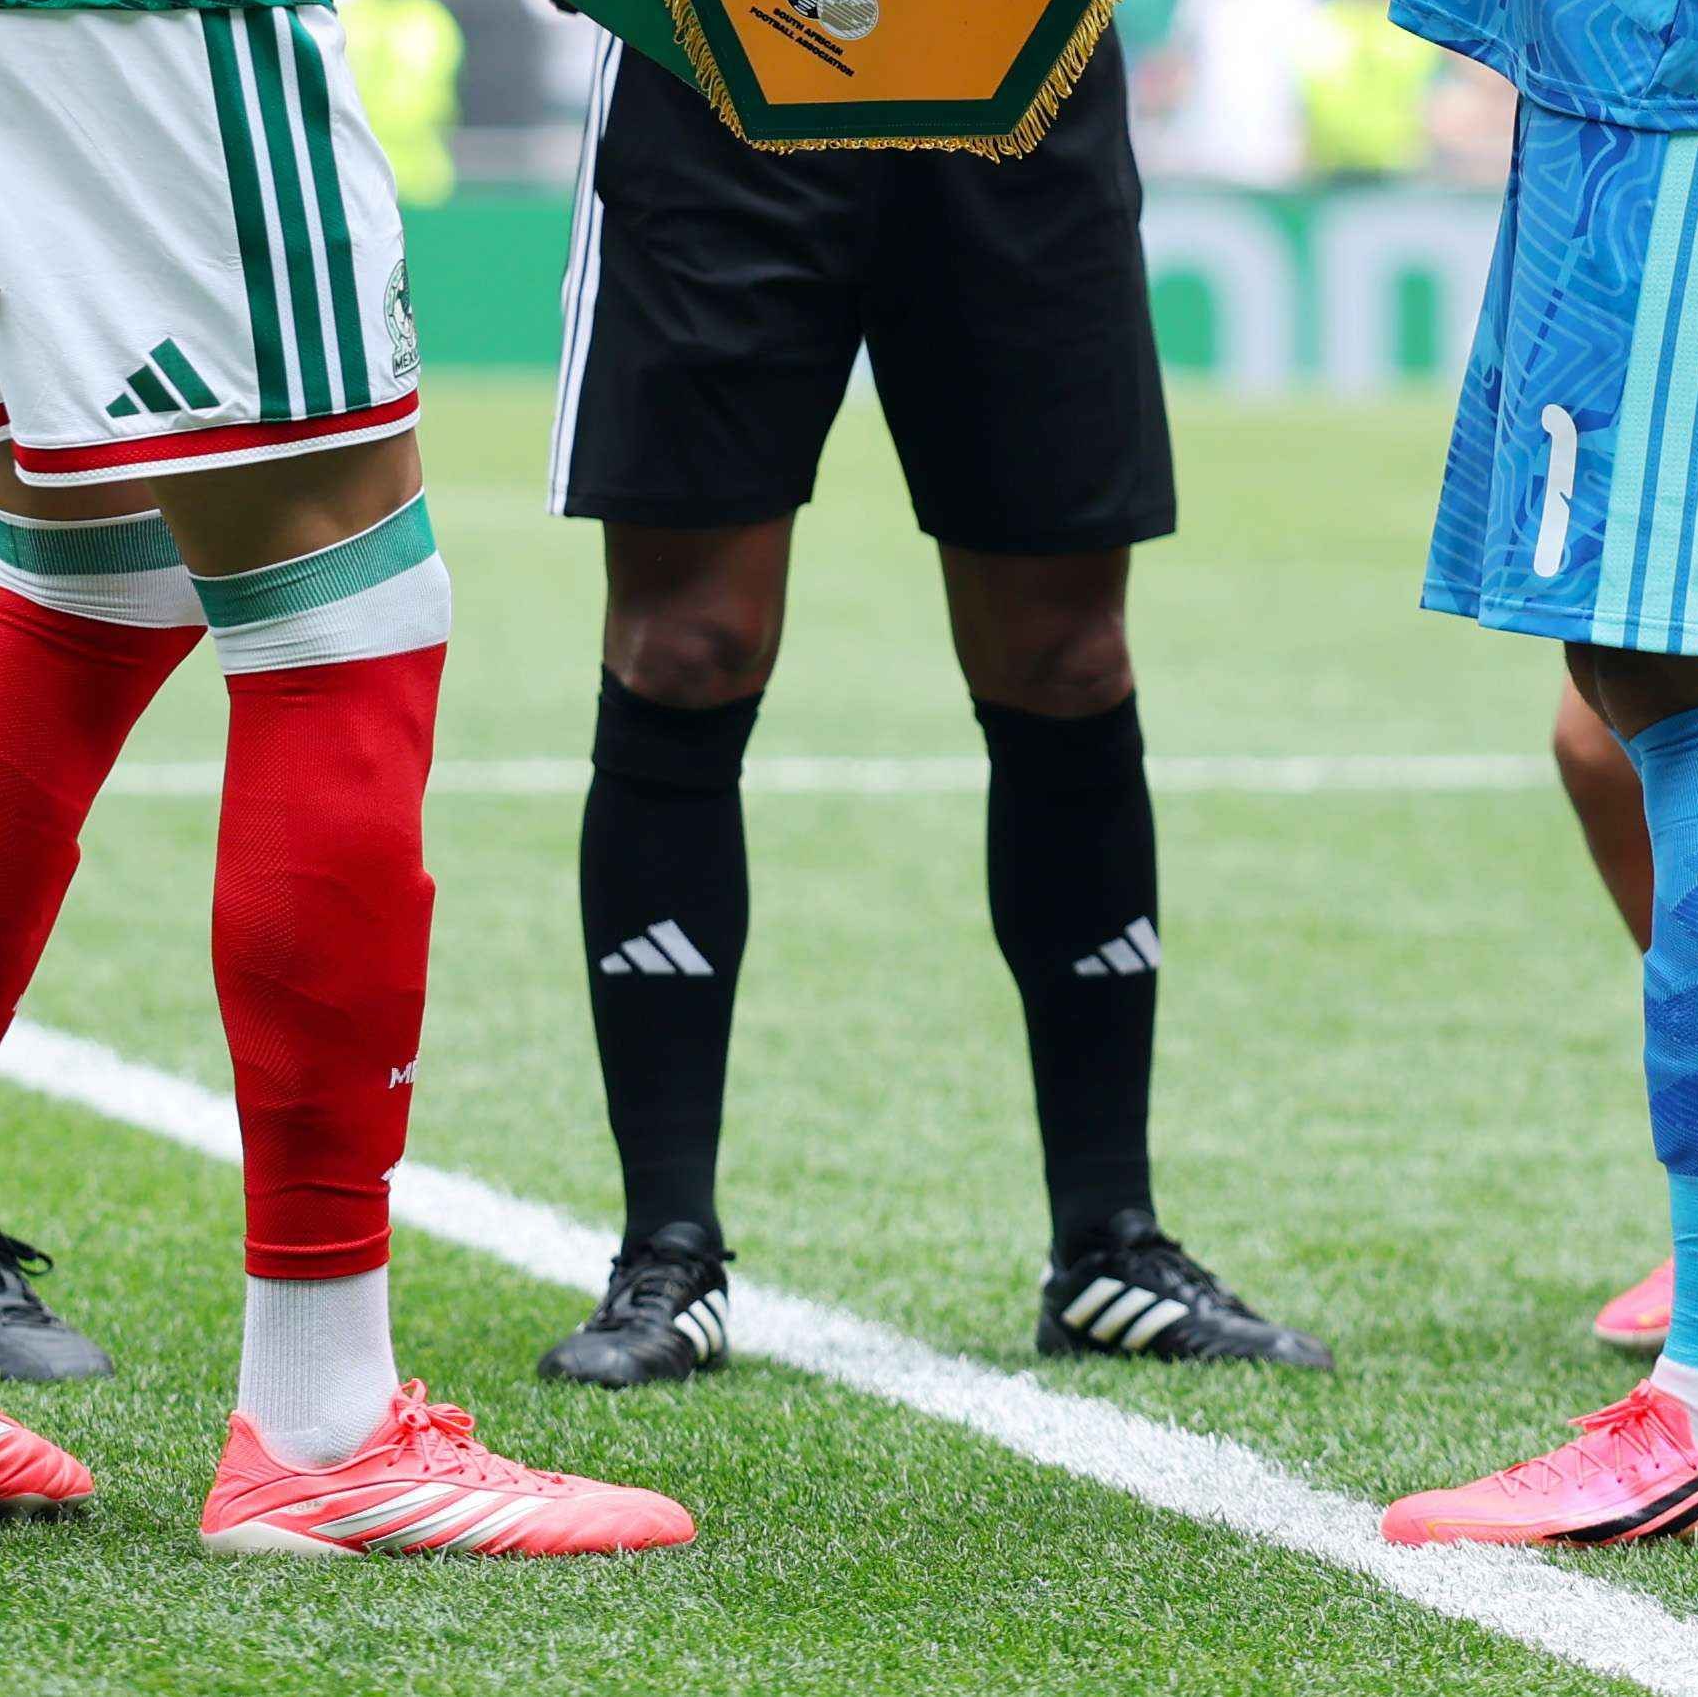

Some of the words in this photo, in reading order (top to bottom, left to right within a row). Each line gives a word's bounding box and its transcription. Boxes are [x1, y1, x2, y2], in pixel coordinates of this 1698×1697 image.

[749, 6, 795, 39] FOOTBALL
[795, 36, 855, 77] ASSOCIATION
[773, 7, 804, 31] SOUTH
[804, 28, 843, 56] AFRICAN
[1533, 404, 1577, 577] 1
